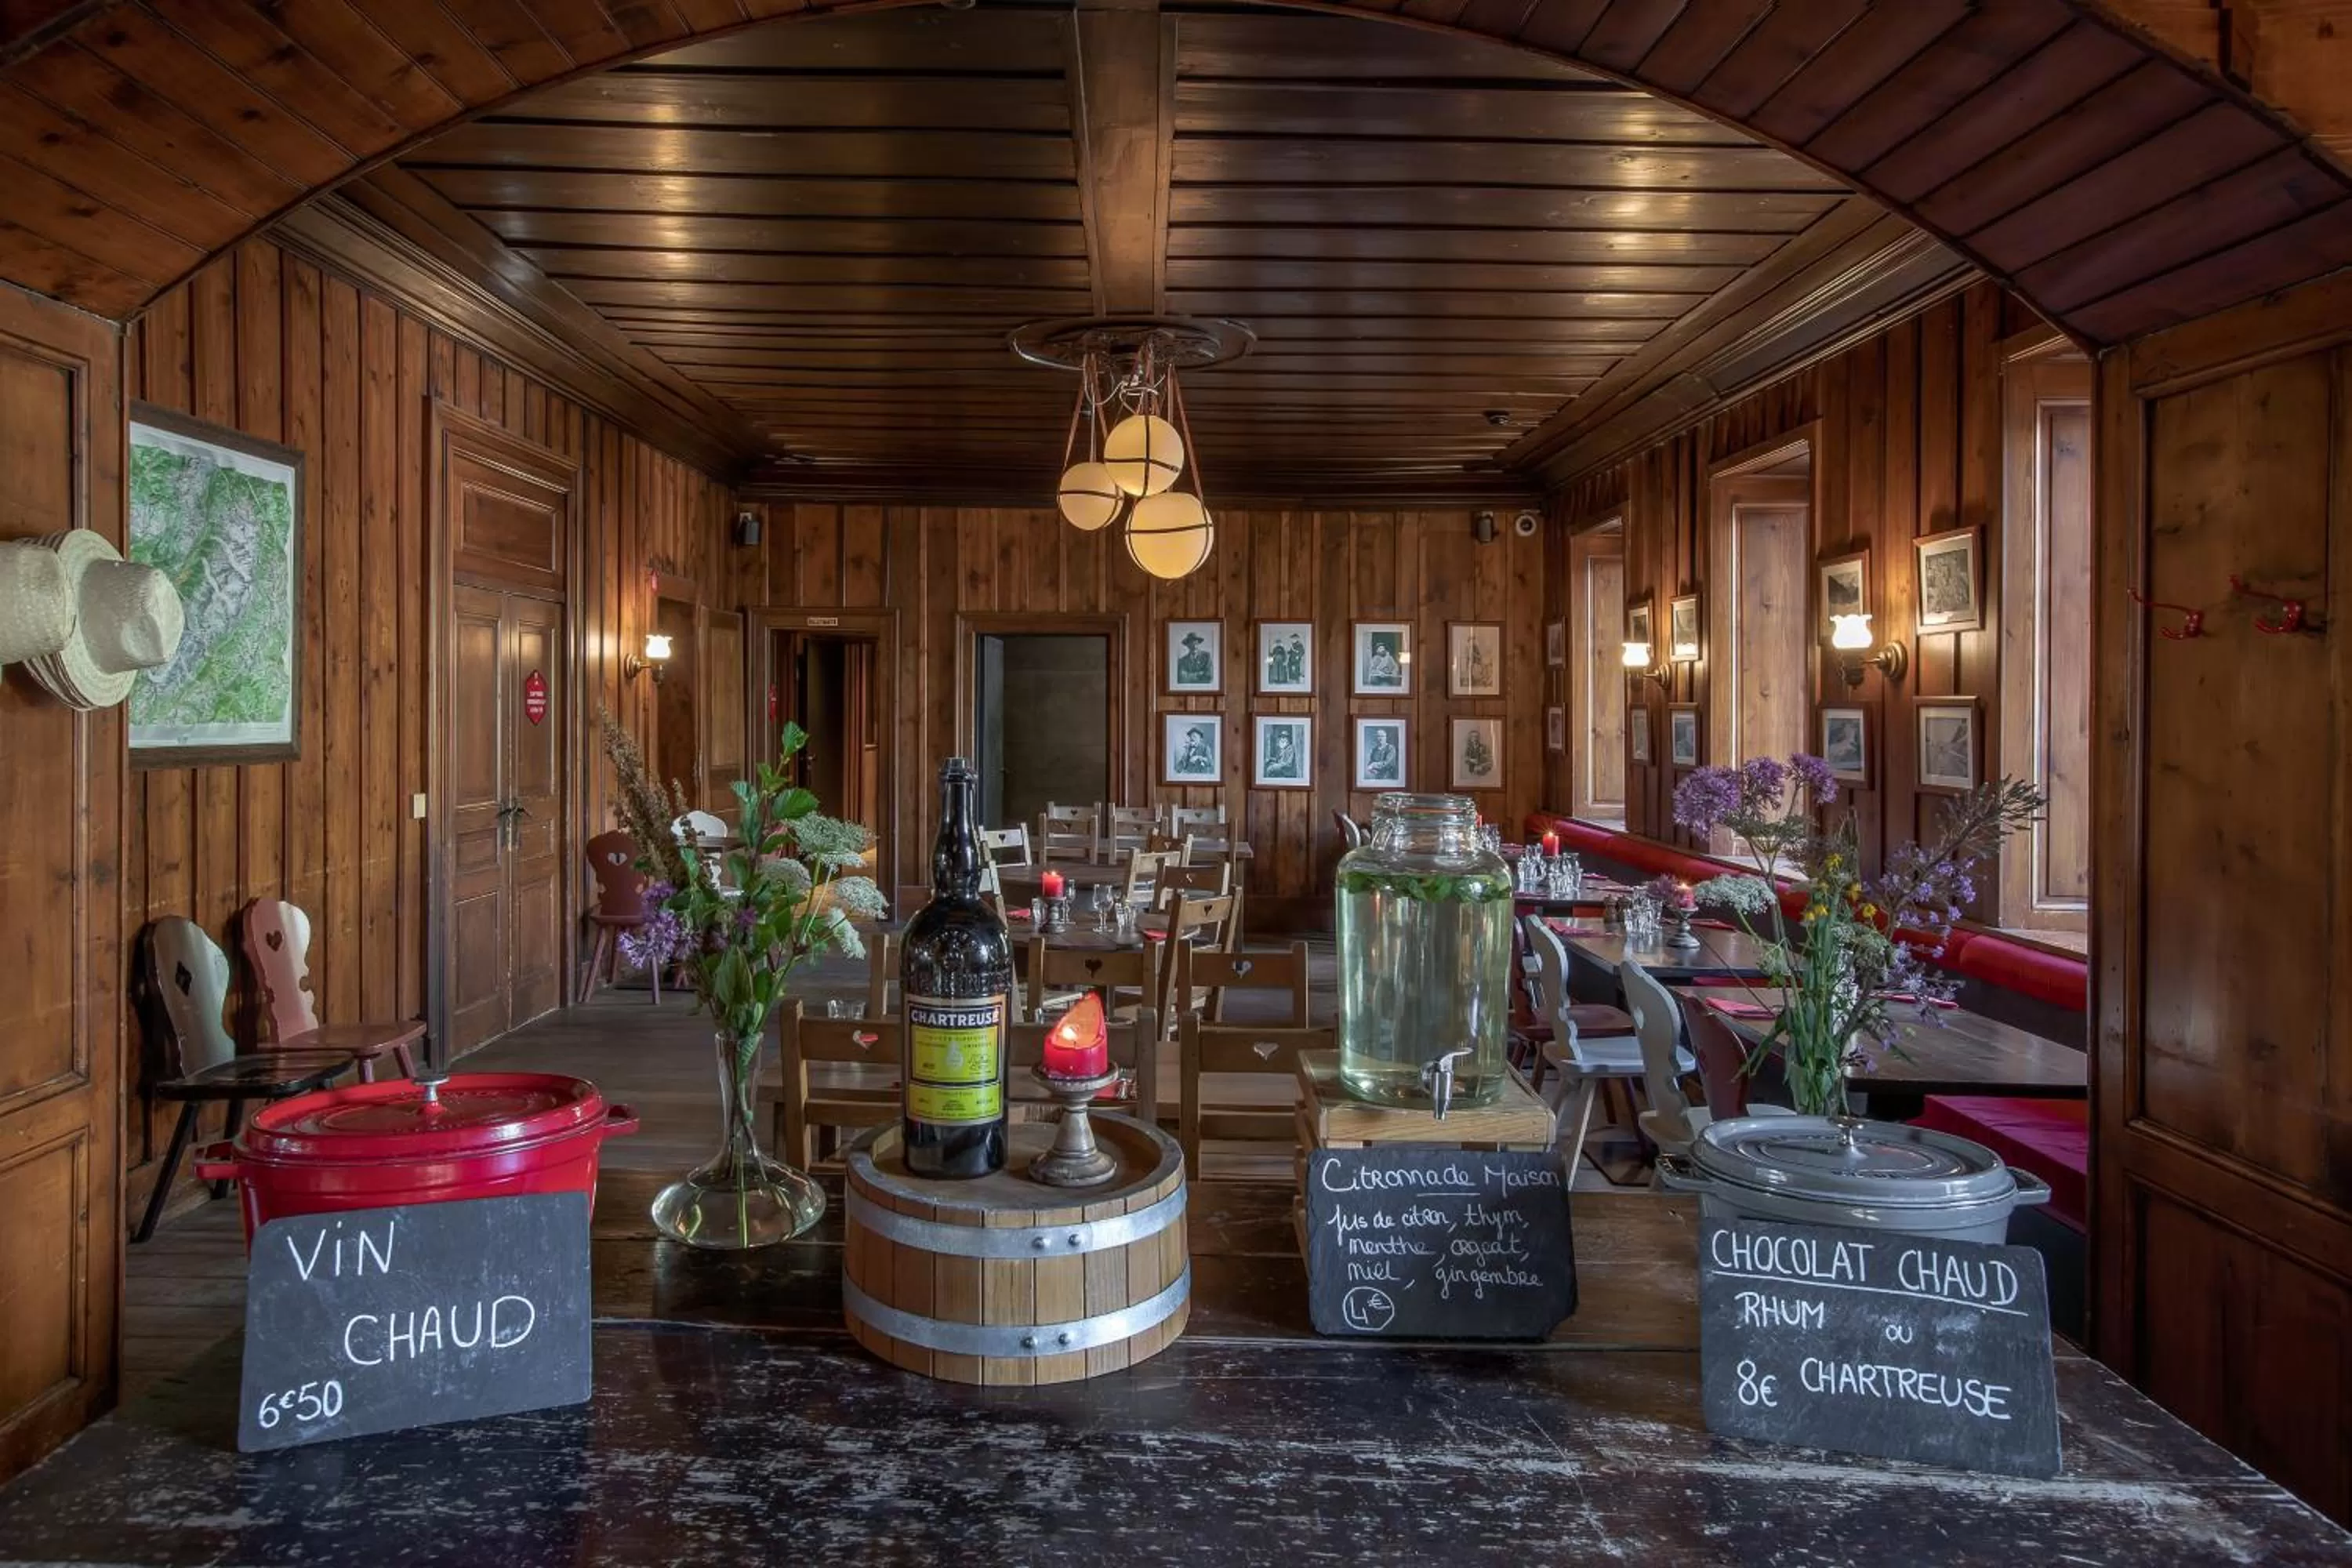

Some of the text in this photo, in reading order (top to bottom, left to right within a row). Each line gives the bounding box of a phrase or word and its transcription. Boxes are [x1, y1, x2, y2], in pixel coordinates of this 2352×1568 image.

[911, 1008, 1000, 1026] CHARTREUSE
[1484, 1164, 1560, 1197] Maison
[1373, 1210, 1396, 1229] de
[1711, 1229, 2019, 1306] CHOCOLAT CHAUD
[344, 1294, 536, 1366] CHAUD
[1734, 1291, 1824, 1329] RHUM
[258, 1379, 343, 1428] 6€50
[1737, 1357, 2013, 1421] 8€ CHARTREUSE
